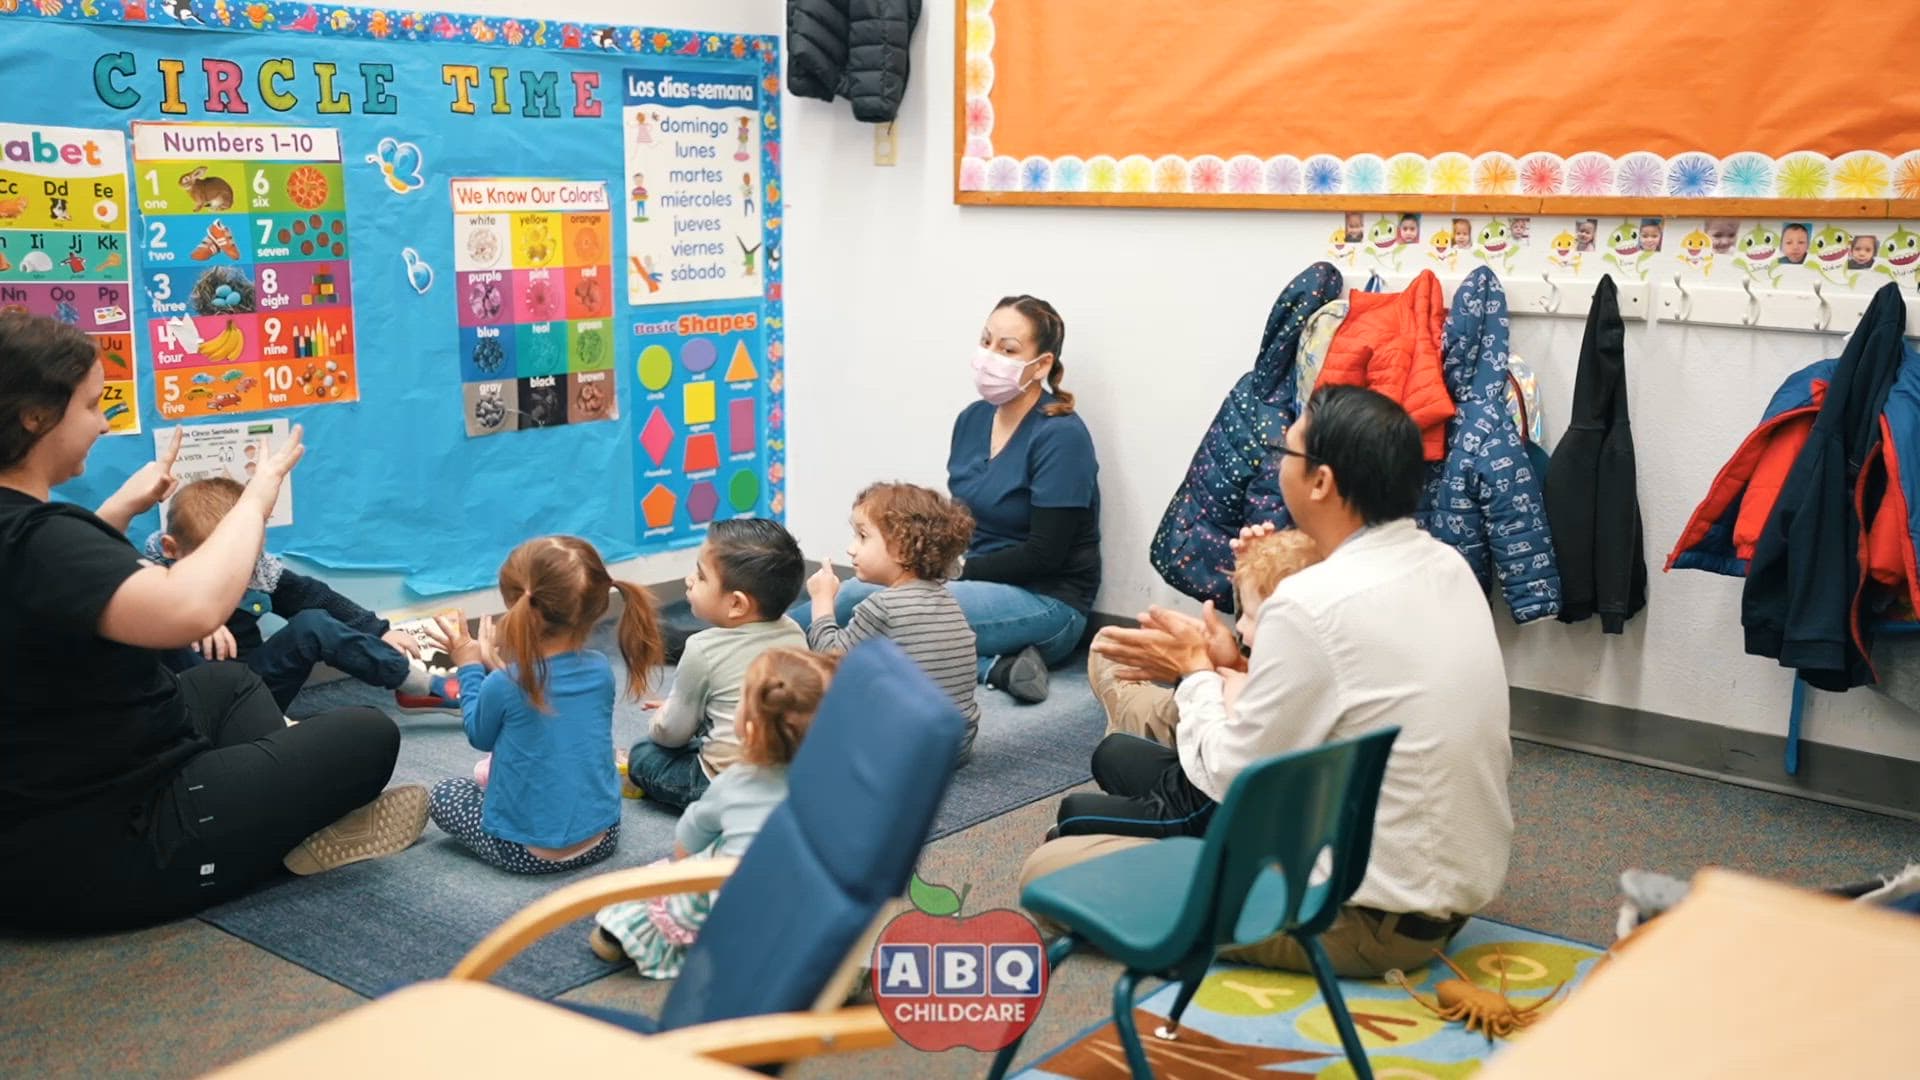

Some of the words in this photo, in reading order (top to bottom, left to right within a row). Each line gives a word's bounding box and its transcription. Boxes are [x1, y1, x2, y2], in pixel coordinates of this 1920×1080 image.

[93, 51, 398, 115] CIRCLE
[442, 64, 603, 118] TIME
[629, 75, 655, 97] Los
[697, 83, 753, 101] semana
[660, 116, 728, 138] domingo
[0, 131, 102, 166] abet
[163, 131, 264, 153] Numbers
[675, 141, 716, 158] lunes
[144, 169, 160, 196] 1
[252, 169, 270, 196] 6
[670, 168, 722, 183] martes
[44, 180, 69, 196] Dd
[94, 183, 113, 198] Ee
[457, 187, 482, 204] We
[487, 187, 527, 204] Know
[531, 186, 556, 203] Our
[559, 186, 604, 203] Colors!
[144, 200, 168, 209] one
[252, 195, 270, 208] six
[661, 189, 732, 208] miércoles
[469, 214, 496, 225] white
[519, 214, 549, 227] yellow
[570, 215, 601, 225] orange
[673, 215, 721, 237] jueves
[149, 221, 168, 249] 2
[256, 219, 273, 245] 7
[69, 234, 82, 253] Jj
[97, 235, 119, 250] Kk
[671, 240, 724, 256] viernes
[148, 250, 175, 261] two
[257, 247, 290, 257] seven
[468, 269, 503, 284] purple
[528, 268, 550, 281] pink
[581, 265, 597, 277] red
[671, 262, 726, 281] sábado
[152, 273, 171, 300] 3
[261, 268, 278, 294] 8
[1, 287, 27, 301] Nn
[50, 287, 75, 301] Oo
[98, 287, 119, 304] Pp
[261, 293, 290, 309] eight
[152, 299, 187, 313] three
[264, 317, 282, 343] 9
[577, 320, 603, 333] green
[634, 321, 677, 335] Basic
[677, 312, 758, 336] Shapes
[157, 325, 176, 350] 4
[476, 326, 500, 338] blue
[100, 336, 122, 351] Uu
[263, 343, 289, 356] nine
[157, 351, 184, 364] four
[263, 365, 293, 391] 10
[530, 376, 556, 388] black
[578, 371, 605, 383] brown
[103, 385, 123, 400] Zz
[163, 375, 180, 402] 5
[268, 392, 288, 403] ten
[162, 401, 185, 414] five
